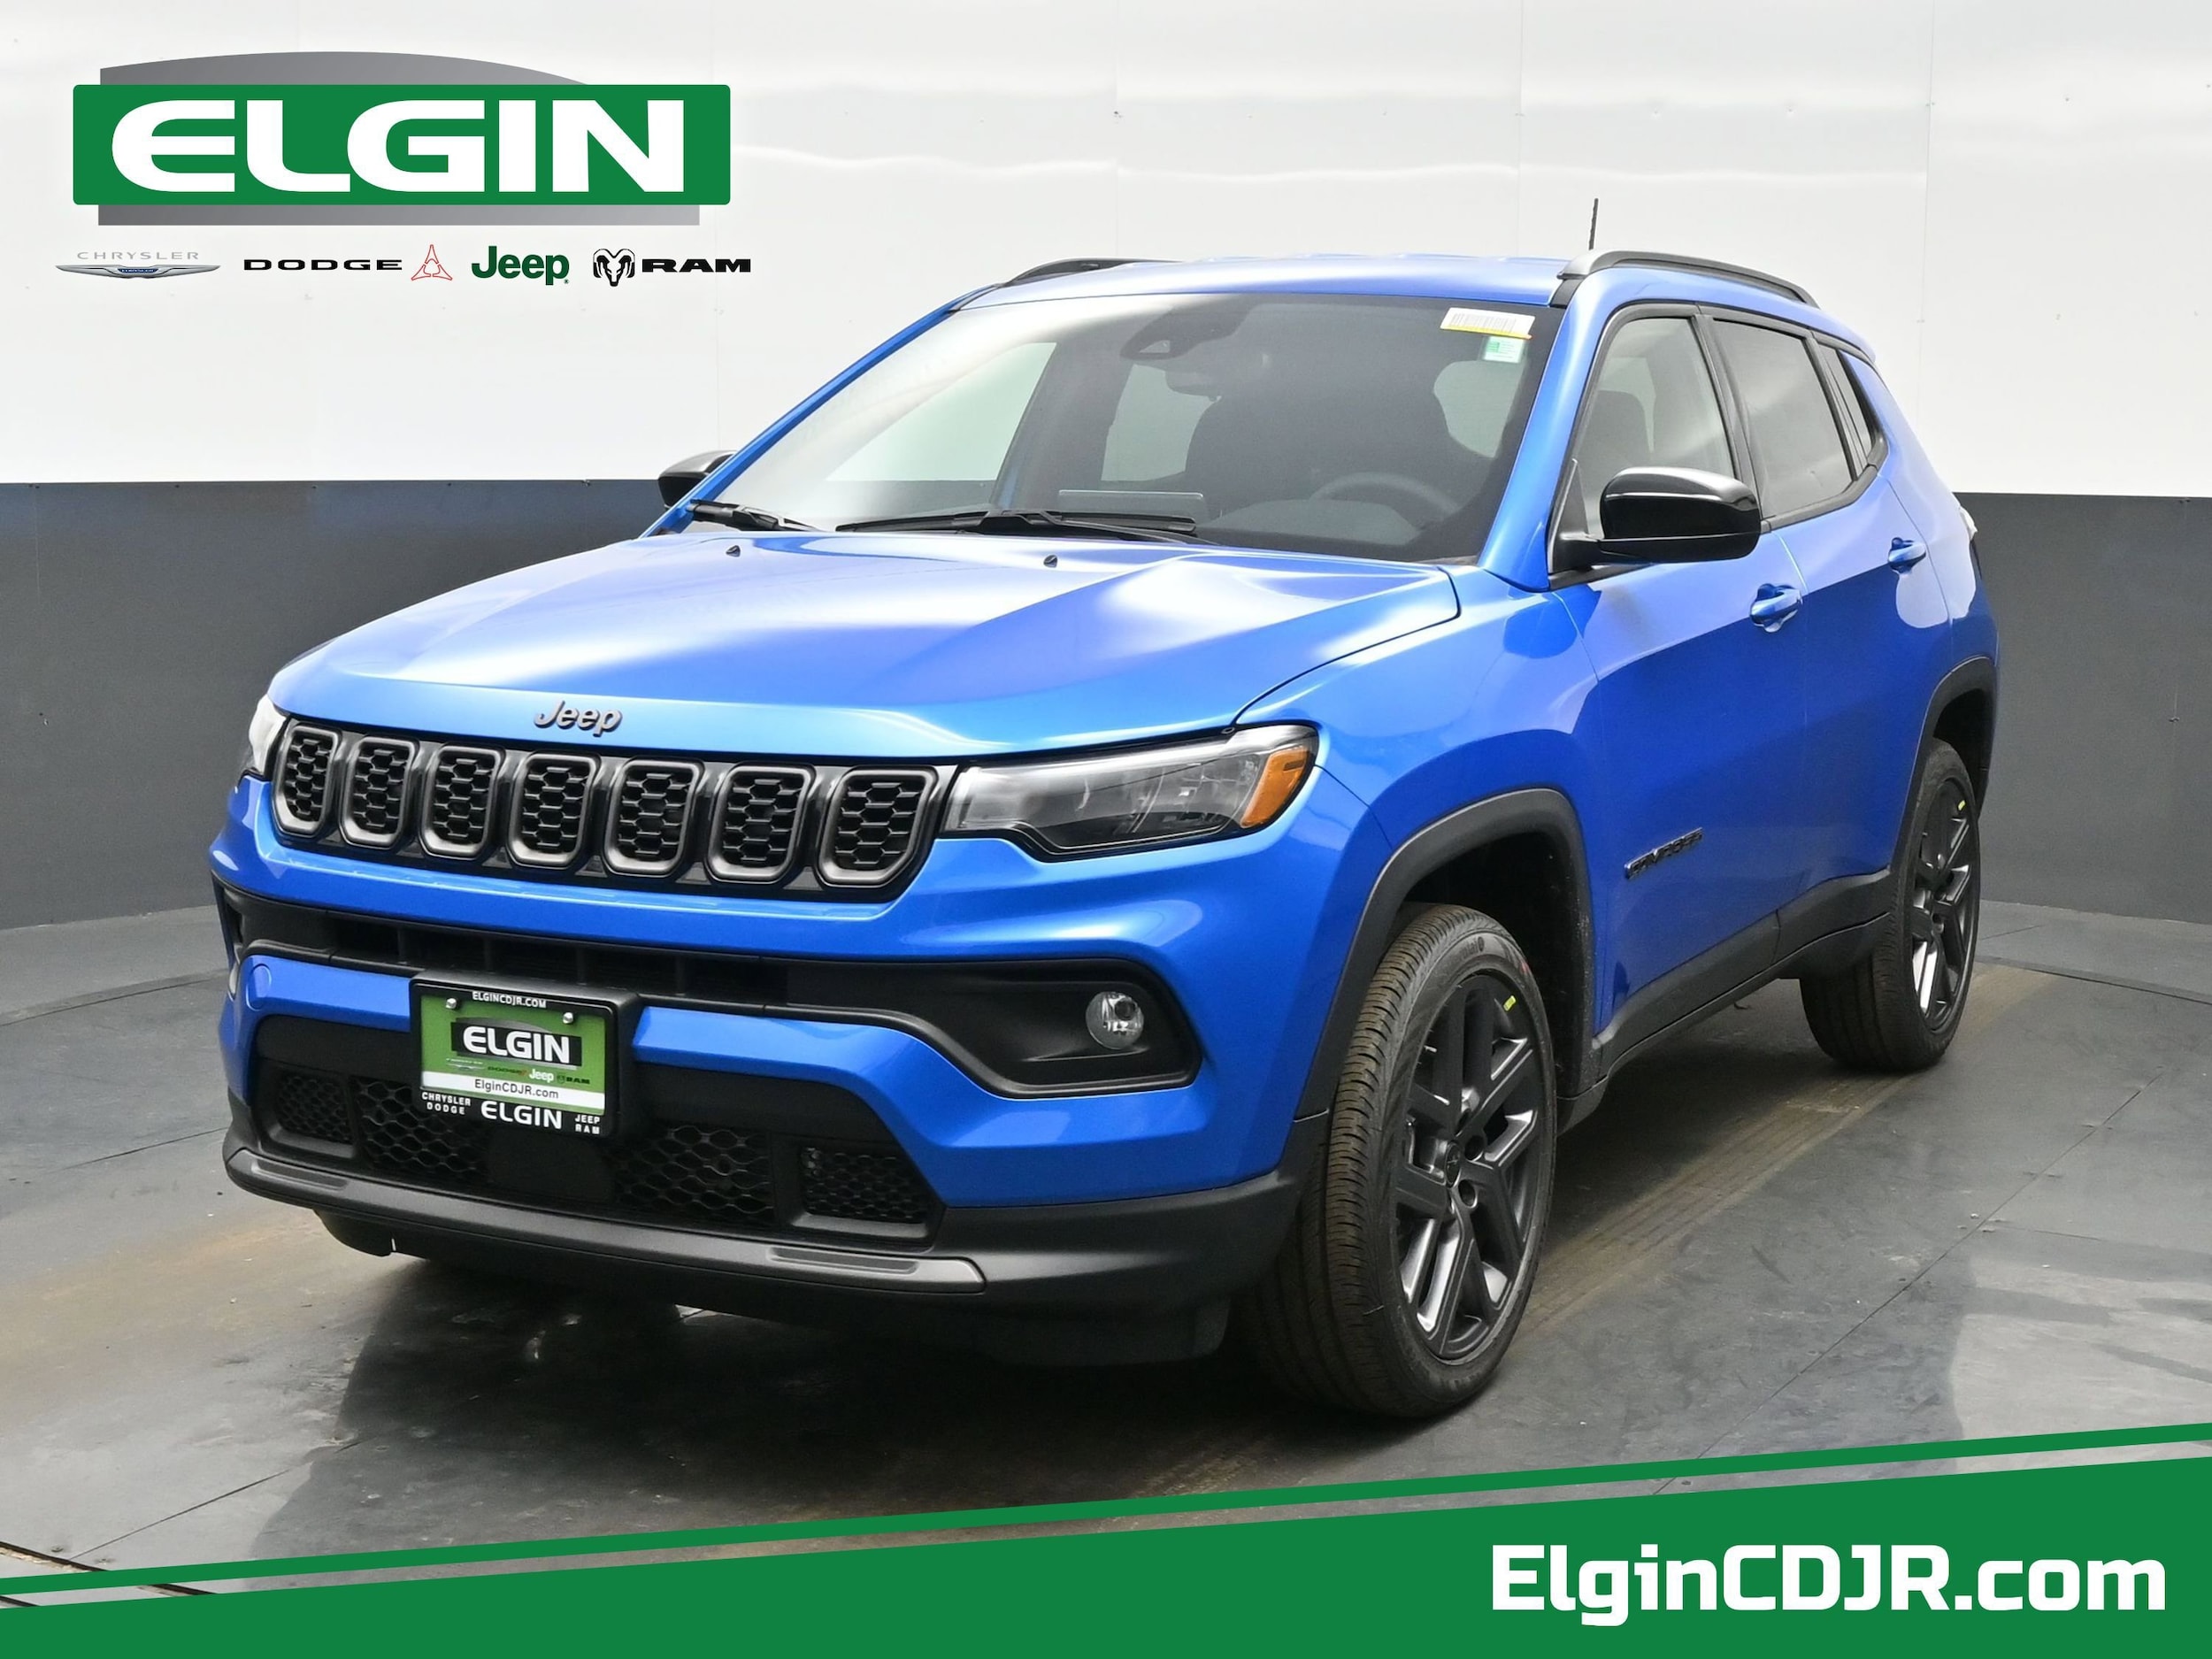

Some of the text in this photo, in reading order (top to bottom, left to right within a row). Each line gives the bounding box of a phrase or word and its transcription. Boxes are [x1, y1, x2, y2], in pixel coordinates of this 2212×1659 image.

[534, 701, 622, 737] Jeep
[472, 991, 547, 1008] ELGINCDJR.COM
[463, 1025, 570, 1064] ELGIN
[529, 1069, 555, 1083] Jeep
[474, 1079, 559, 1099] ElginCDJR.com
[421, 1091, 471, 1107] CHRYSLER
[426, 1103, 465, 1115] DODGE
[480, 1101, 563, 1130] ELGIN
[575, 1114, 601, 1125] JEEP
[575, 1125, 601, 1135] RAM
